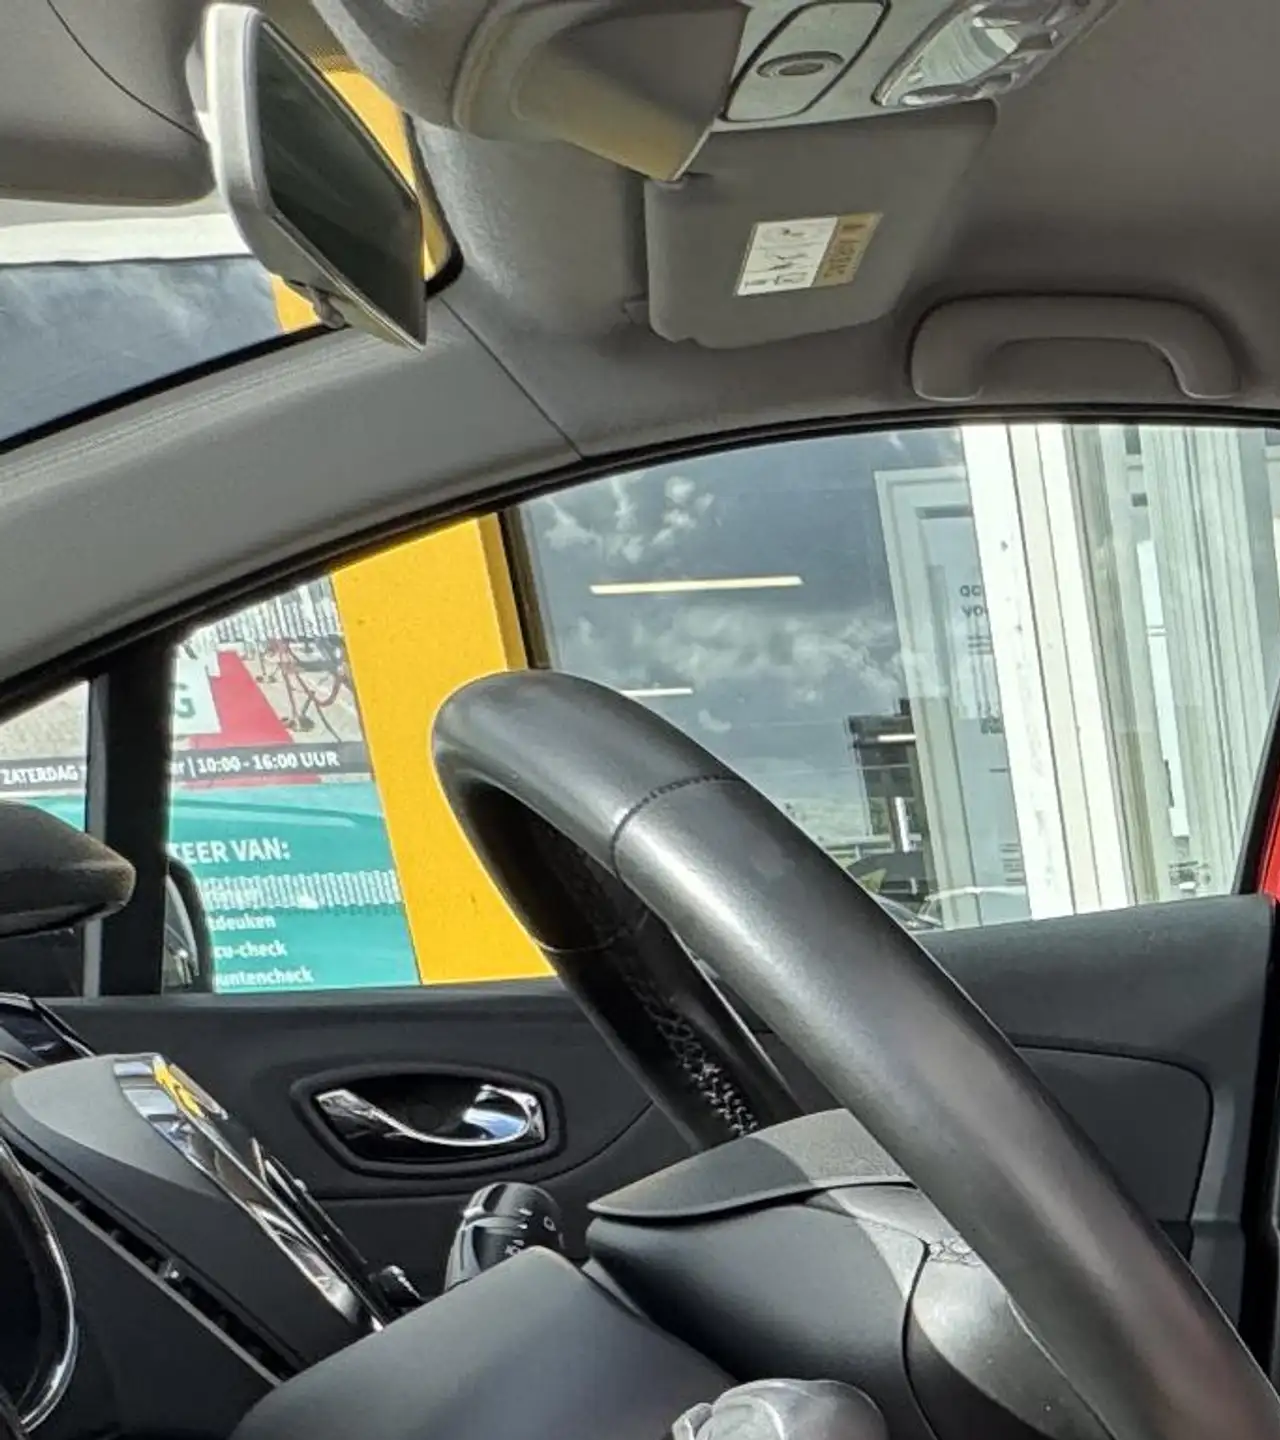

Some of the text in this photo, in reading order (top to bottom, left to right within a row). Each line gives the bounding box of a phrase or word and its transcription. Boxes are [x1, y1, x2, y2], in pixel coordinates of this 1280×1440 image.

[0, 765, 79, 785] ZATERDAG
[197, 755, 240, 774] 10:00
[252, 752, 297, 771] 16:00
[300, 750, 341, 768] UUR
[229, 836, 292, 863] VAN:
[213, 966, 315, 986] untencheck
